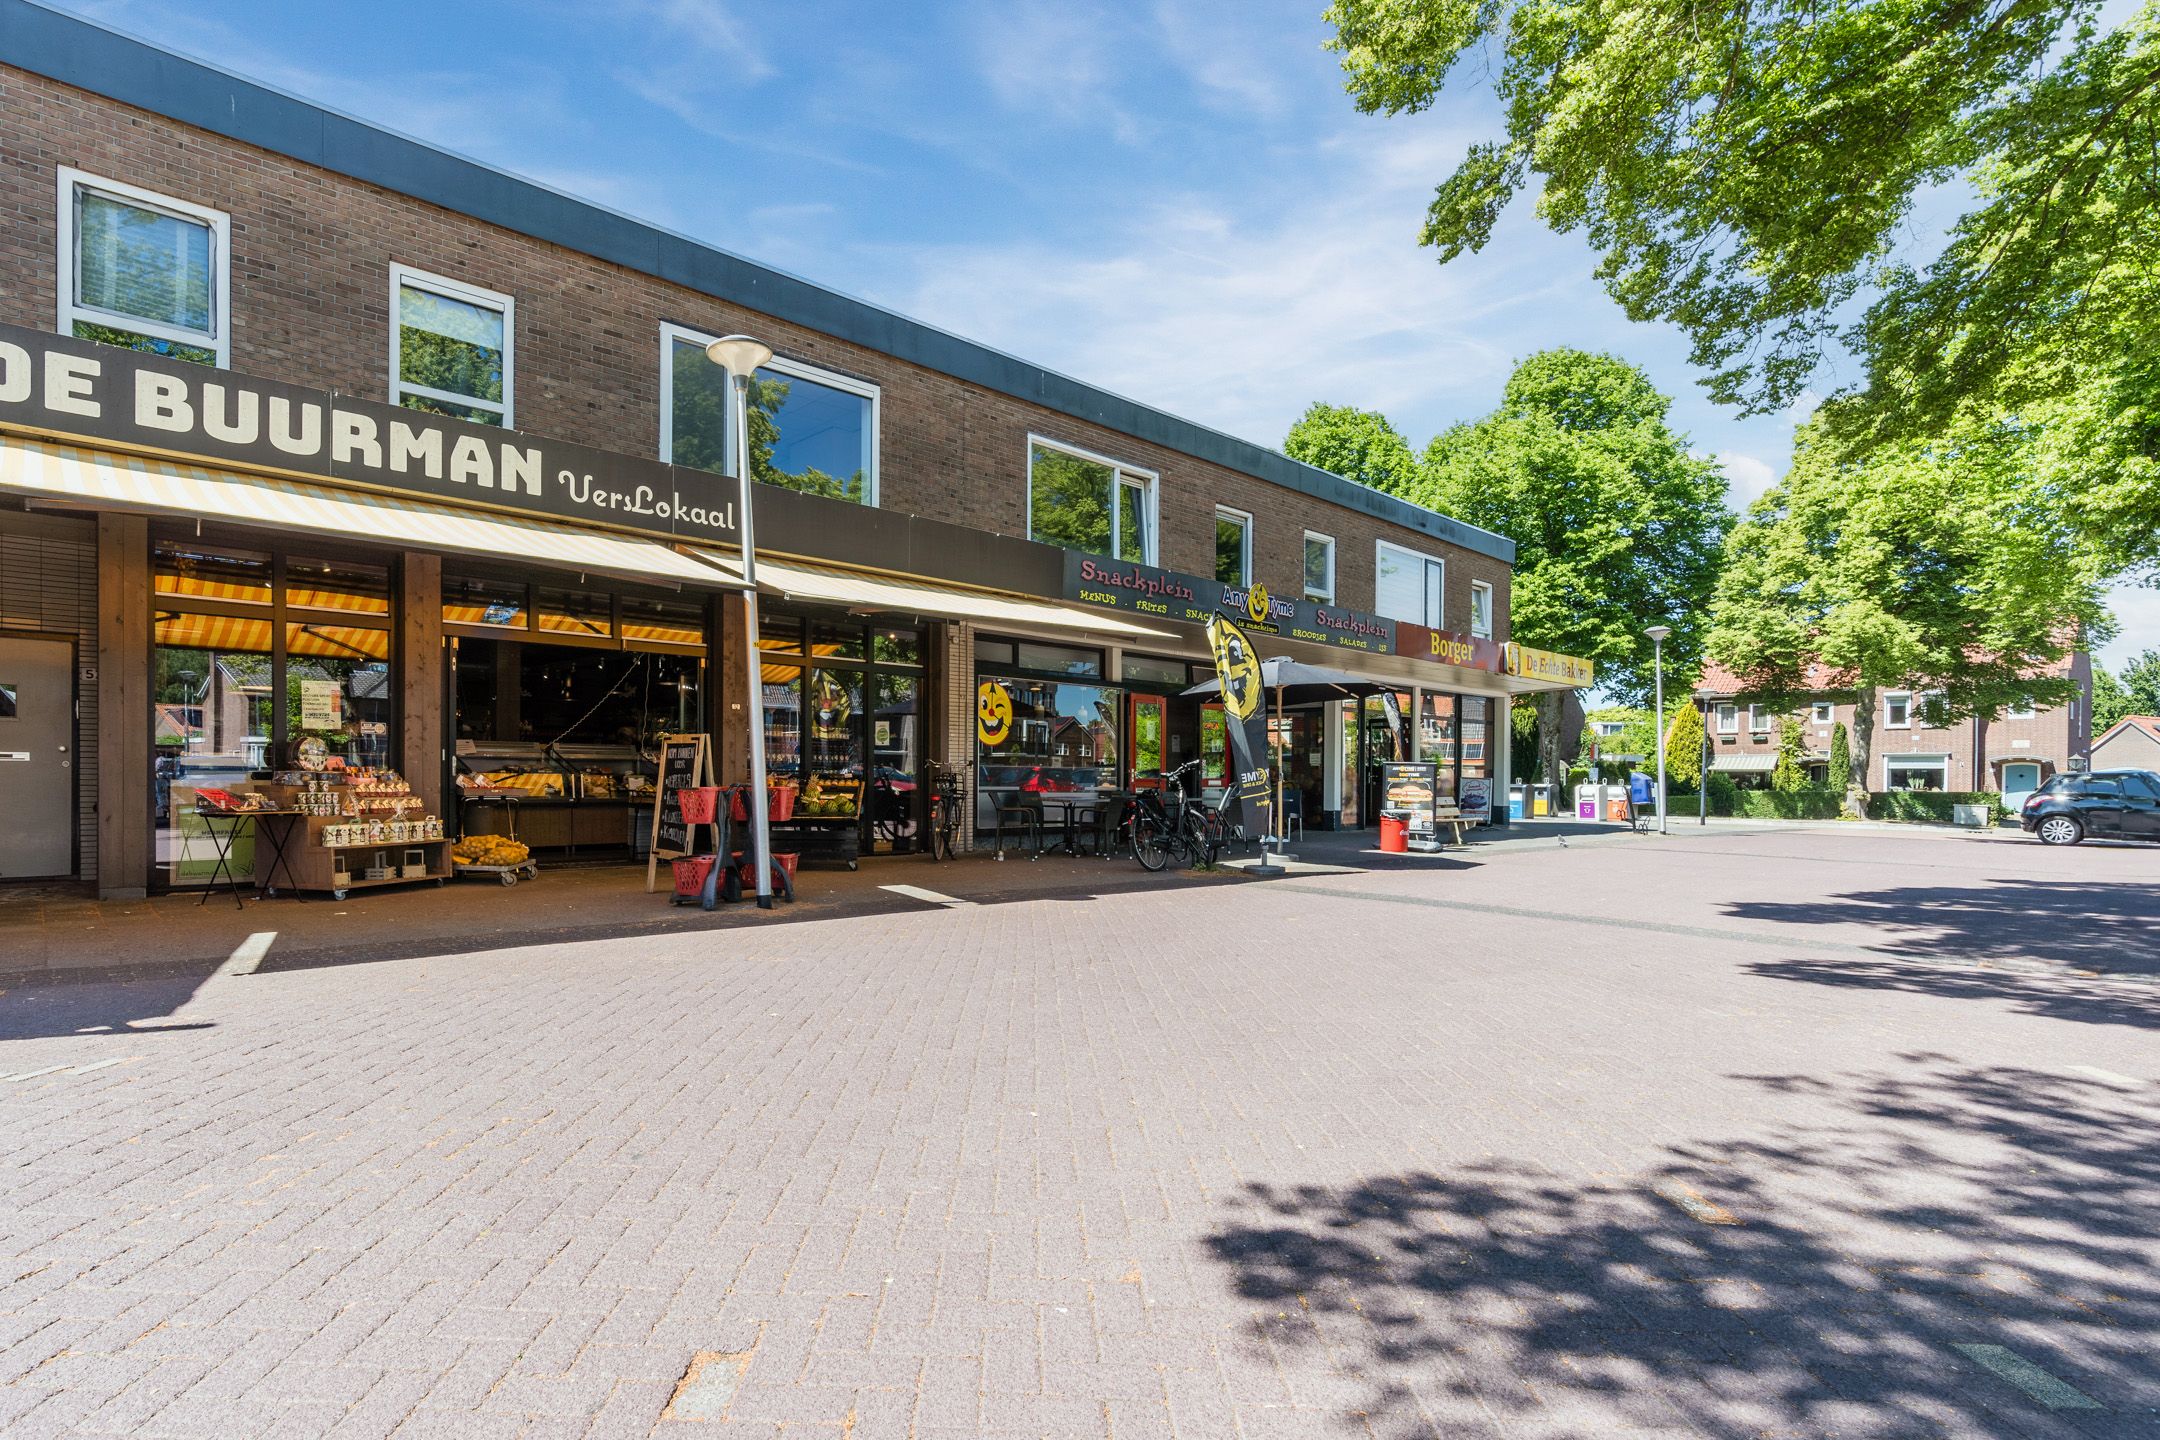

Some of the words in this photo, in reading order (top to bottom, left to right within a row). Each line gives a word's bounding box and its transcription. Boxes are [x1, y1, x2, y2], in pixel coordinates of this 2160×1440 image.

[135, 369, 542, 497] BUURMAN
[558, 470, 736, 530] VersLokaal
[1081, 560, 1195, 601] Snackplein
[1079, 590, 1117, 605] MENU'S
[1136, 600, 1168, 614] FRITES
[1292, 628, 1327, 642] BROODJES
[1339, 636, 1368, 649] SALADES
[1316, 609, 1389, 639] Snackplein
[1430, 632, 1474, 664] Borger
[86, 669, 94, 679] 5
[1526, 654, 1538, 671] De
[1539, 656, 1560, 676] Echte
[1561, 662, 1588, 681] Bakker
